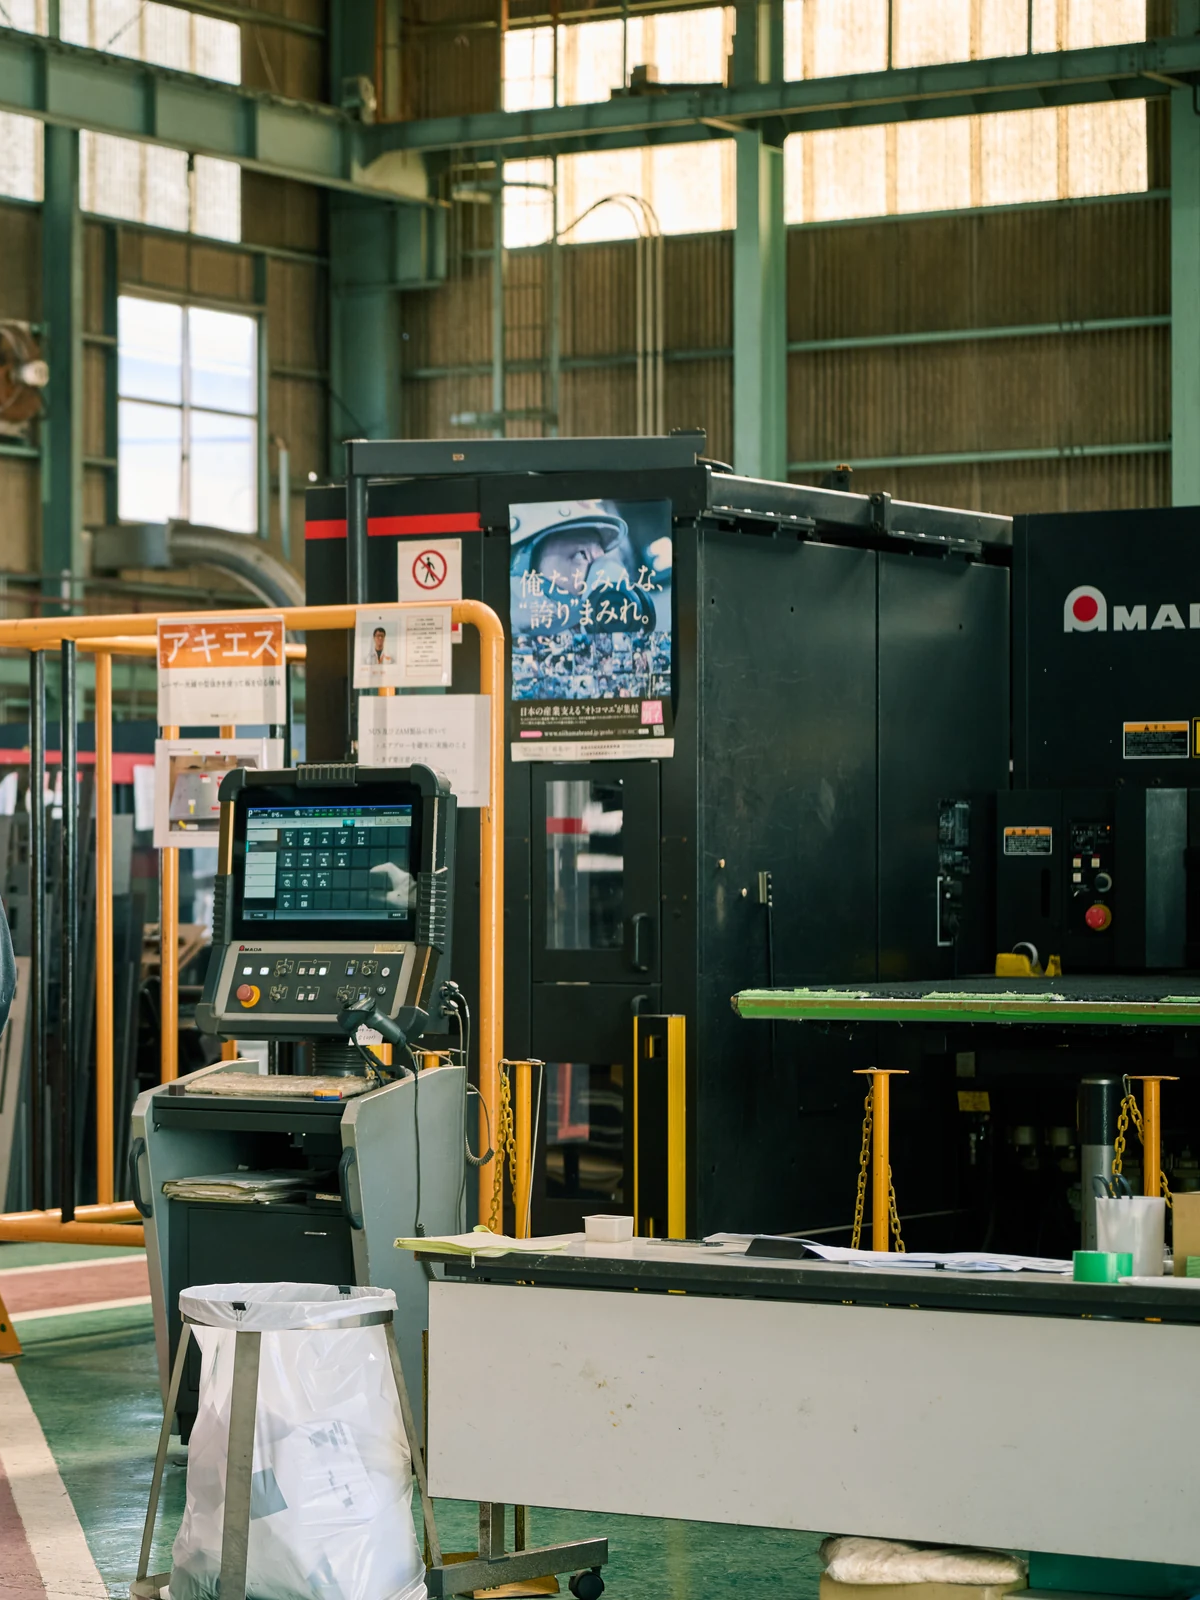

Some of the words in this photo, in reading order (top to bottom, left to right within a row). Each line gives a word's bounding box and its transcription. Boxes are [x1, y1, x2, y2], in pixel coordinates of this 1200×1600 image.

[520, 564, 663, 598] 俺たちみんな、
[163, 628, 279, 663] アキエス
[239, 944, 262, 952] AMADA
